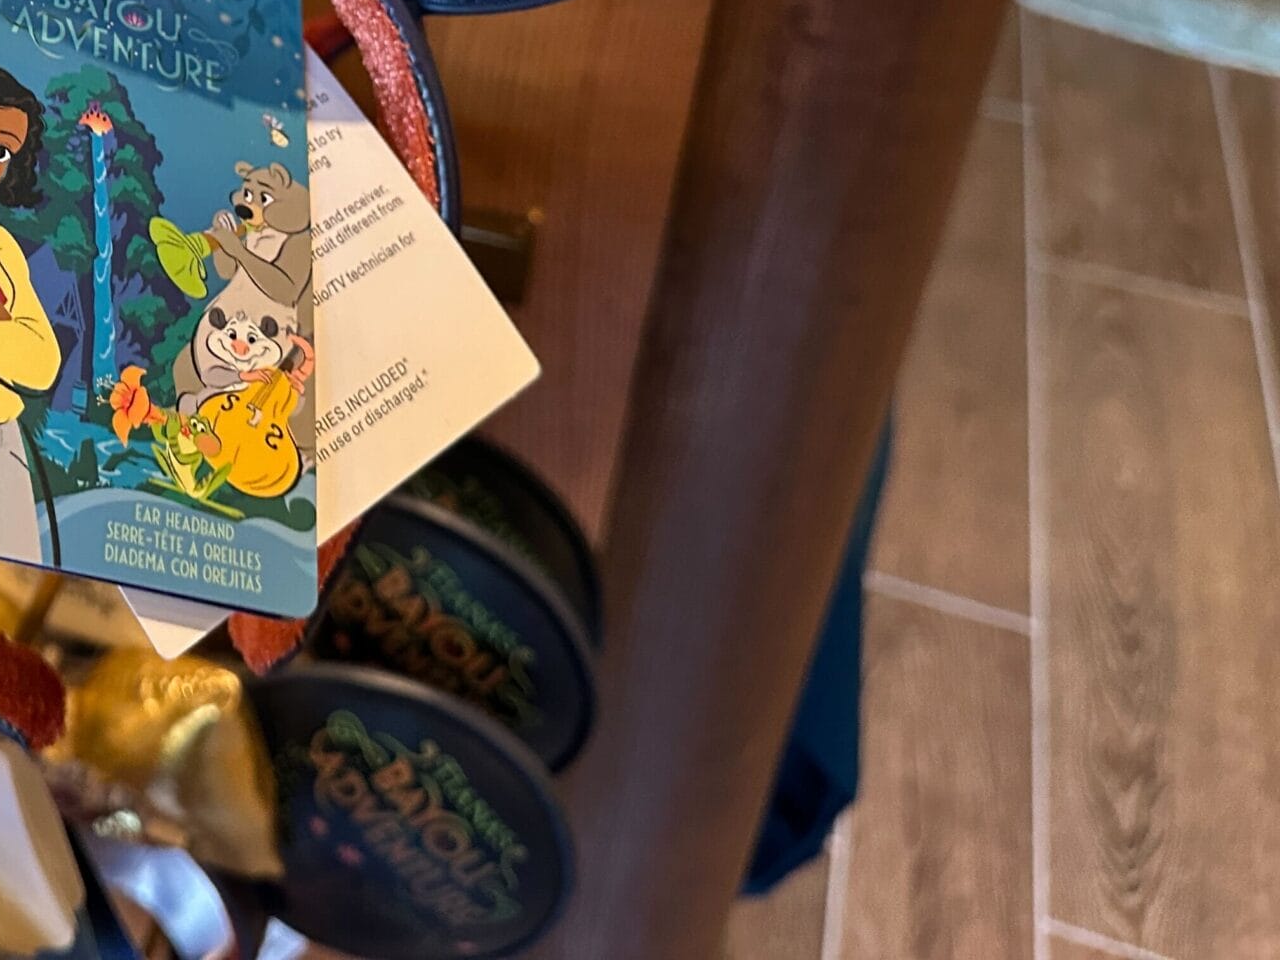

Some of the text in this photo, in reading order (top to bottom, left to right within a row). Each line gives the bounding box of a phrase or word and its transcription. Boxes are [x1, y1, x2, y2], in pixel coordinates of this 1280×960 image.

[11, 5, 223, 93] ADVENTURE
[313, 136, 328, 149] to
[325, 125, 343, 142] try
[323, 209, 345, 231] and
[343, 184, 390, 218] receiver.
[336, 209, 380, 246] different
[377, 196, 404, 218] from
[346, 235, 401, 284] technician
[399, 230, 416, 249] for
[316, 446, 331, 463] in
[328, 431, 353, 453] use
[351, 420, 365, 437] or
[106, 520, 183, 556] SERRE-TÊTE
[203, 545, 262, 571] OREILLES
[135, 502, 235, 541] EAR HEADBAND
[104, 543, 263, 594] DIADEMA CON OREJITAS
